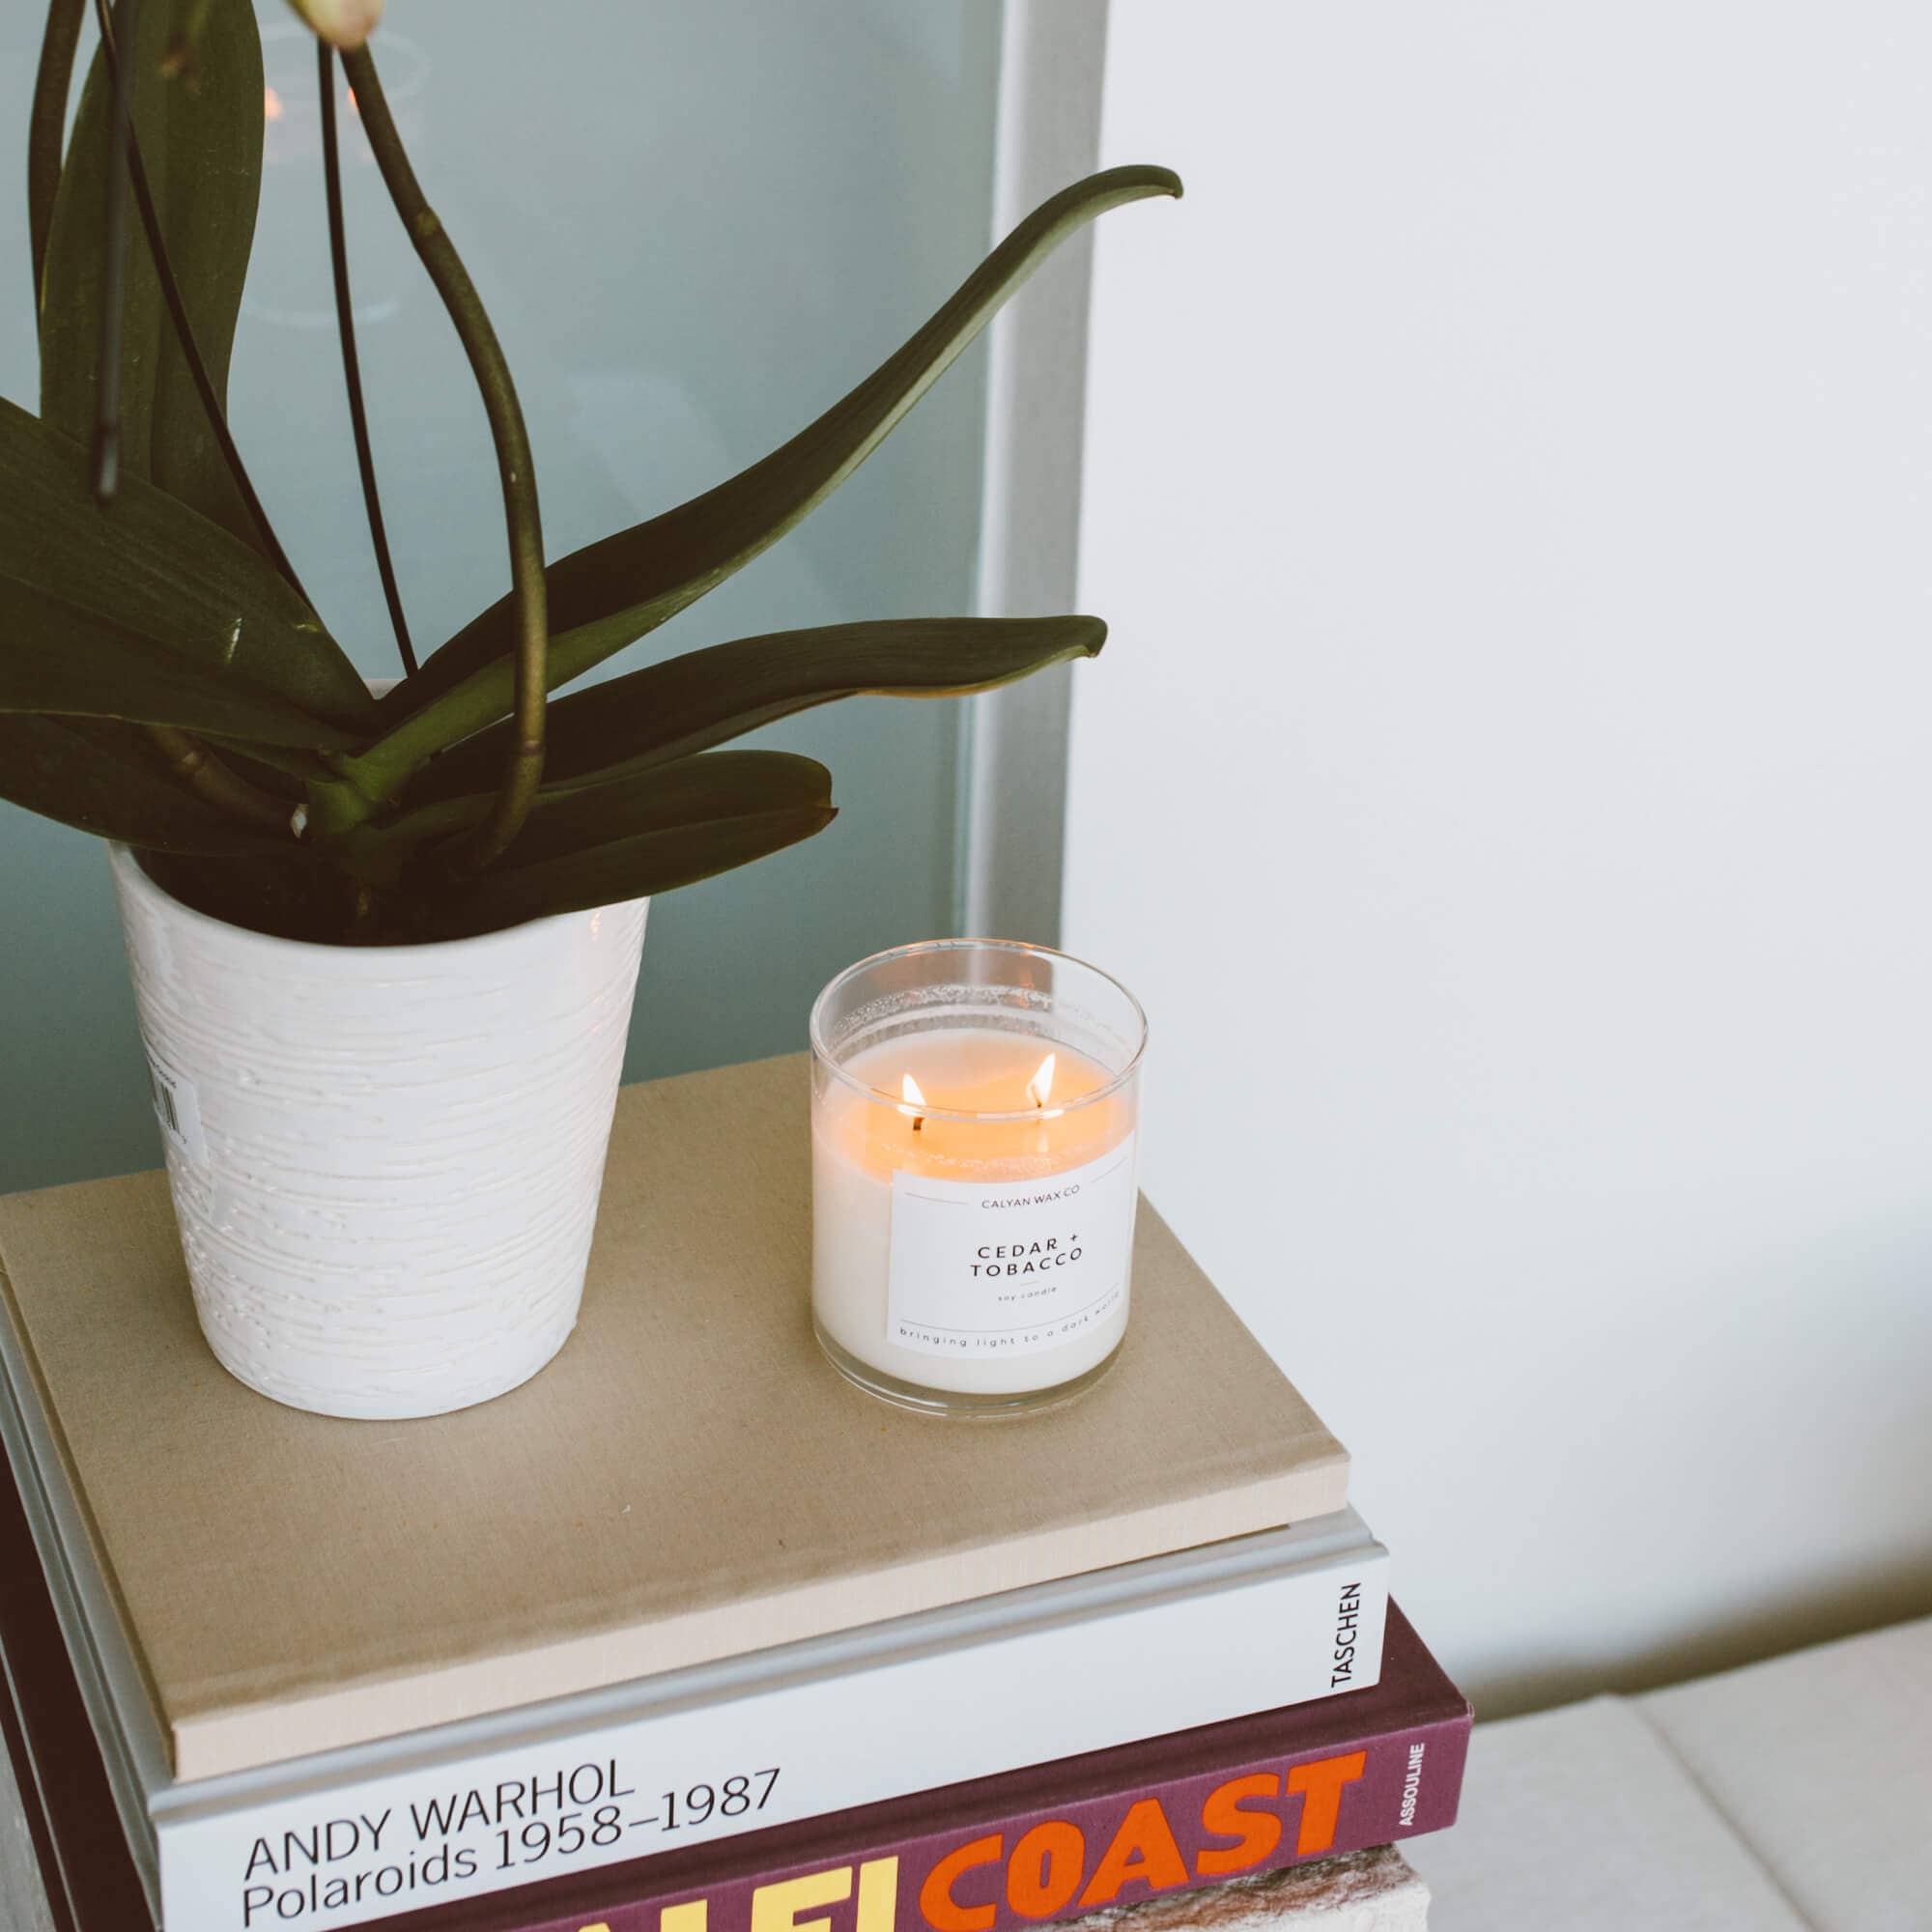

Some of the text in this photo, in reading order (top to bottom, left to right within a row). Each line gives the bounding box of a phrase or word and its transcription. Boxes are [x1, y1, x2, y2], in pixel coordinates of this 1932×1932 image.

[981, 1184, 1080, 1209] CALYAN WAX CO
[970, 1247, 1083, 1277] TOBACCO
[978, 1237, 1058, 1259] CEDAR
[898, 1326, 968, 1348] bringing
[976, 1338, 1016, 1348] light
[1331, 1582, 1361, 1689] TASCHEN
[243, 1759, 636, 1881] ANDY WARHOL
[1399, 1743, 1425, 1827] ASSOULINE
[577, 1749, 1367, 1932] FI COAST
[242, 1843, 478, 1928] Polaroids
